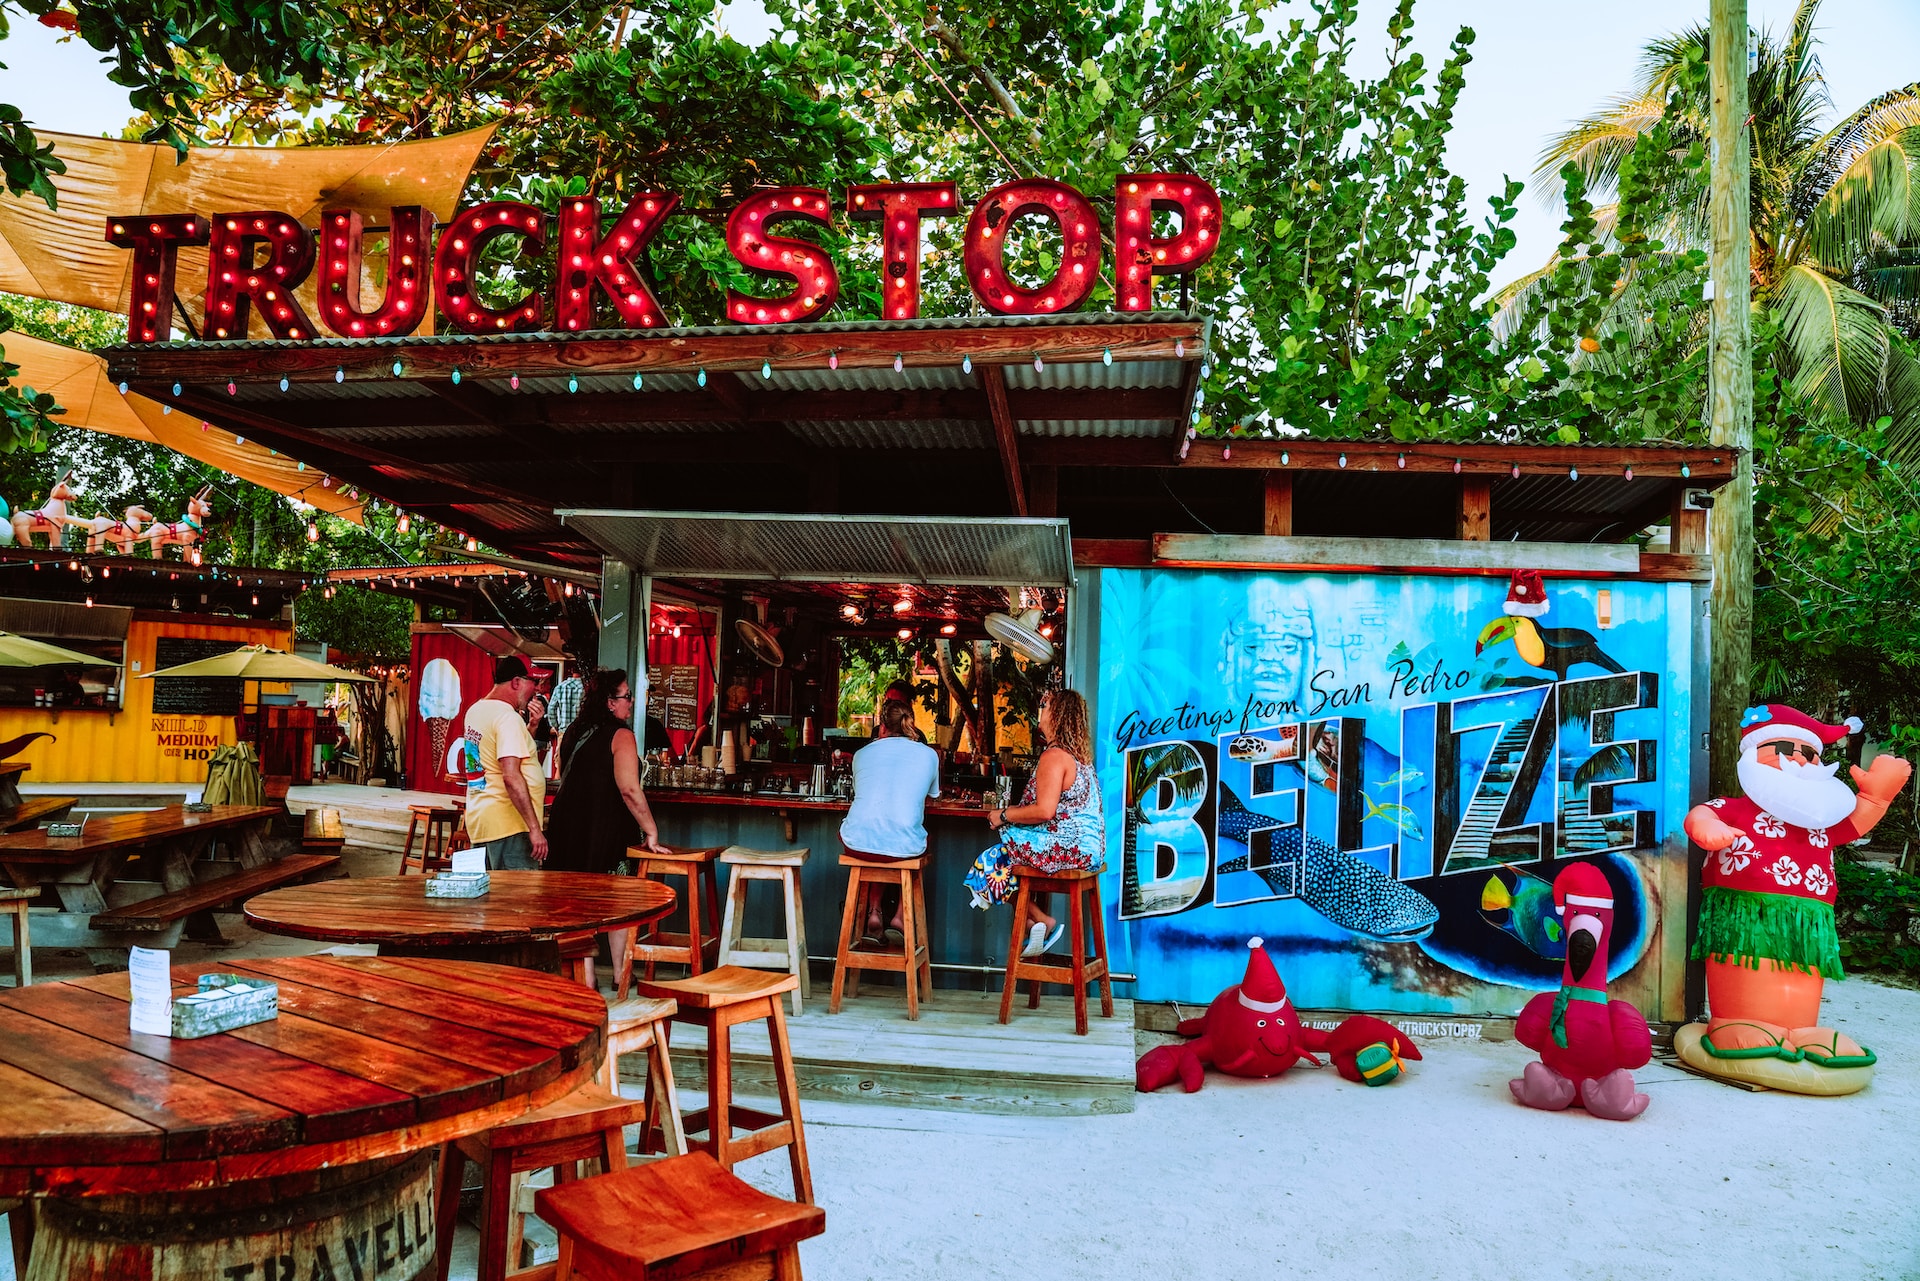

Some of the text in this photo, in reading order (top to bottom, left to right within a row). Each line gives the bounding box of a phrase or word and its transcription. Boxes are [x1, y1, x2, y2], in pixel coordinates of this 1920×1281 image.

[105, 173, 1222, 342] TRUCK STOP
[151, 718, 208, 732] MILD
[157, 734, 219, 747] MEDIUM
[1116, 658, 1470, 753] Greetings from San Pedro
[1118, 671, 1658, 921] BELIZE
[1398, 1021, 1483, 1038] #TRUCKSTOPBZ
[224, 1187, 434, 1281] RAVELLE
